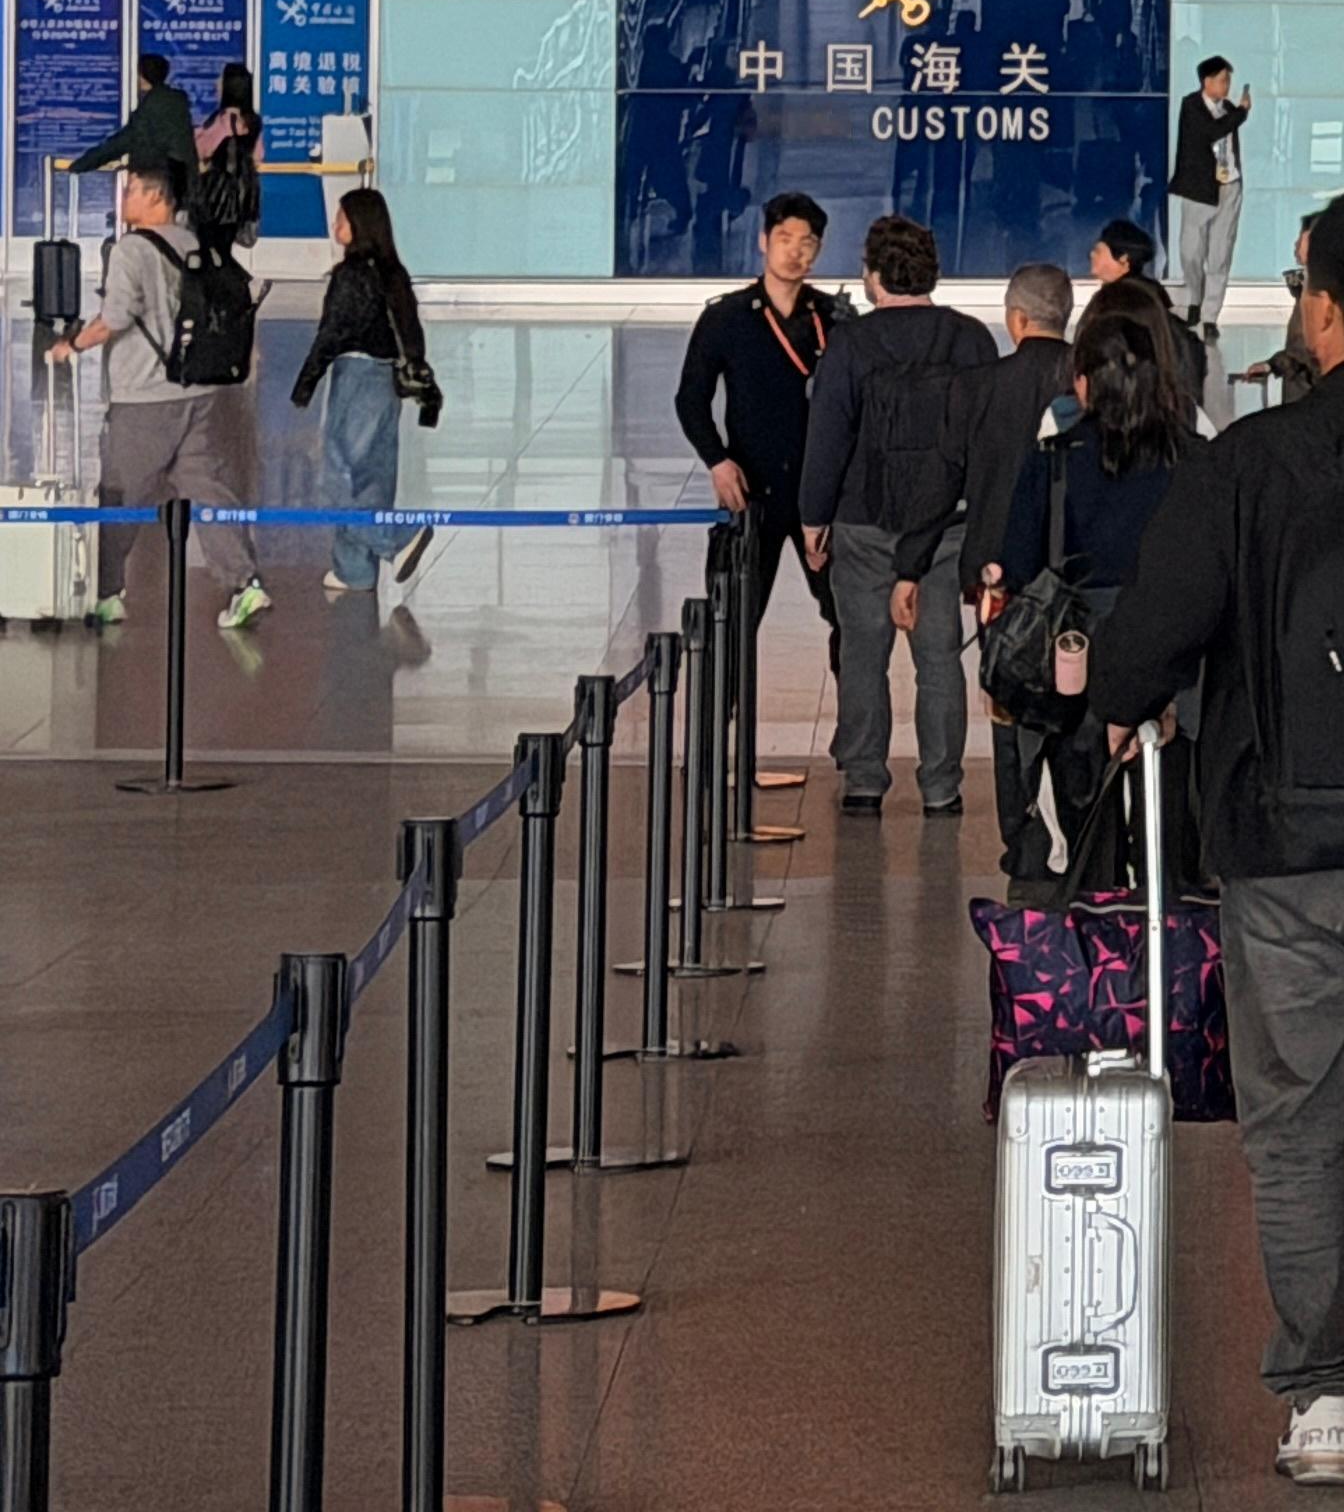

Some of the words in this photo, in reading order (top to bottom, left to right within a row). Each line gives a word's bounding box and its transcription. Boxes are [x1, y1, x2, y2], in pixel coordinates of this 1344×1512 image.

[738, 39, 1050, 95] 中国海关
[871, 105, 1050, 141] CUSTOMS
[374, 511, 452, 525] SECURITY
